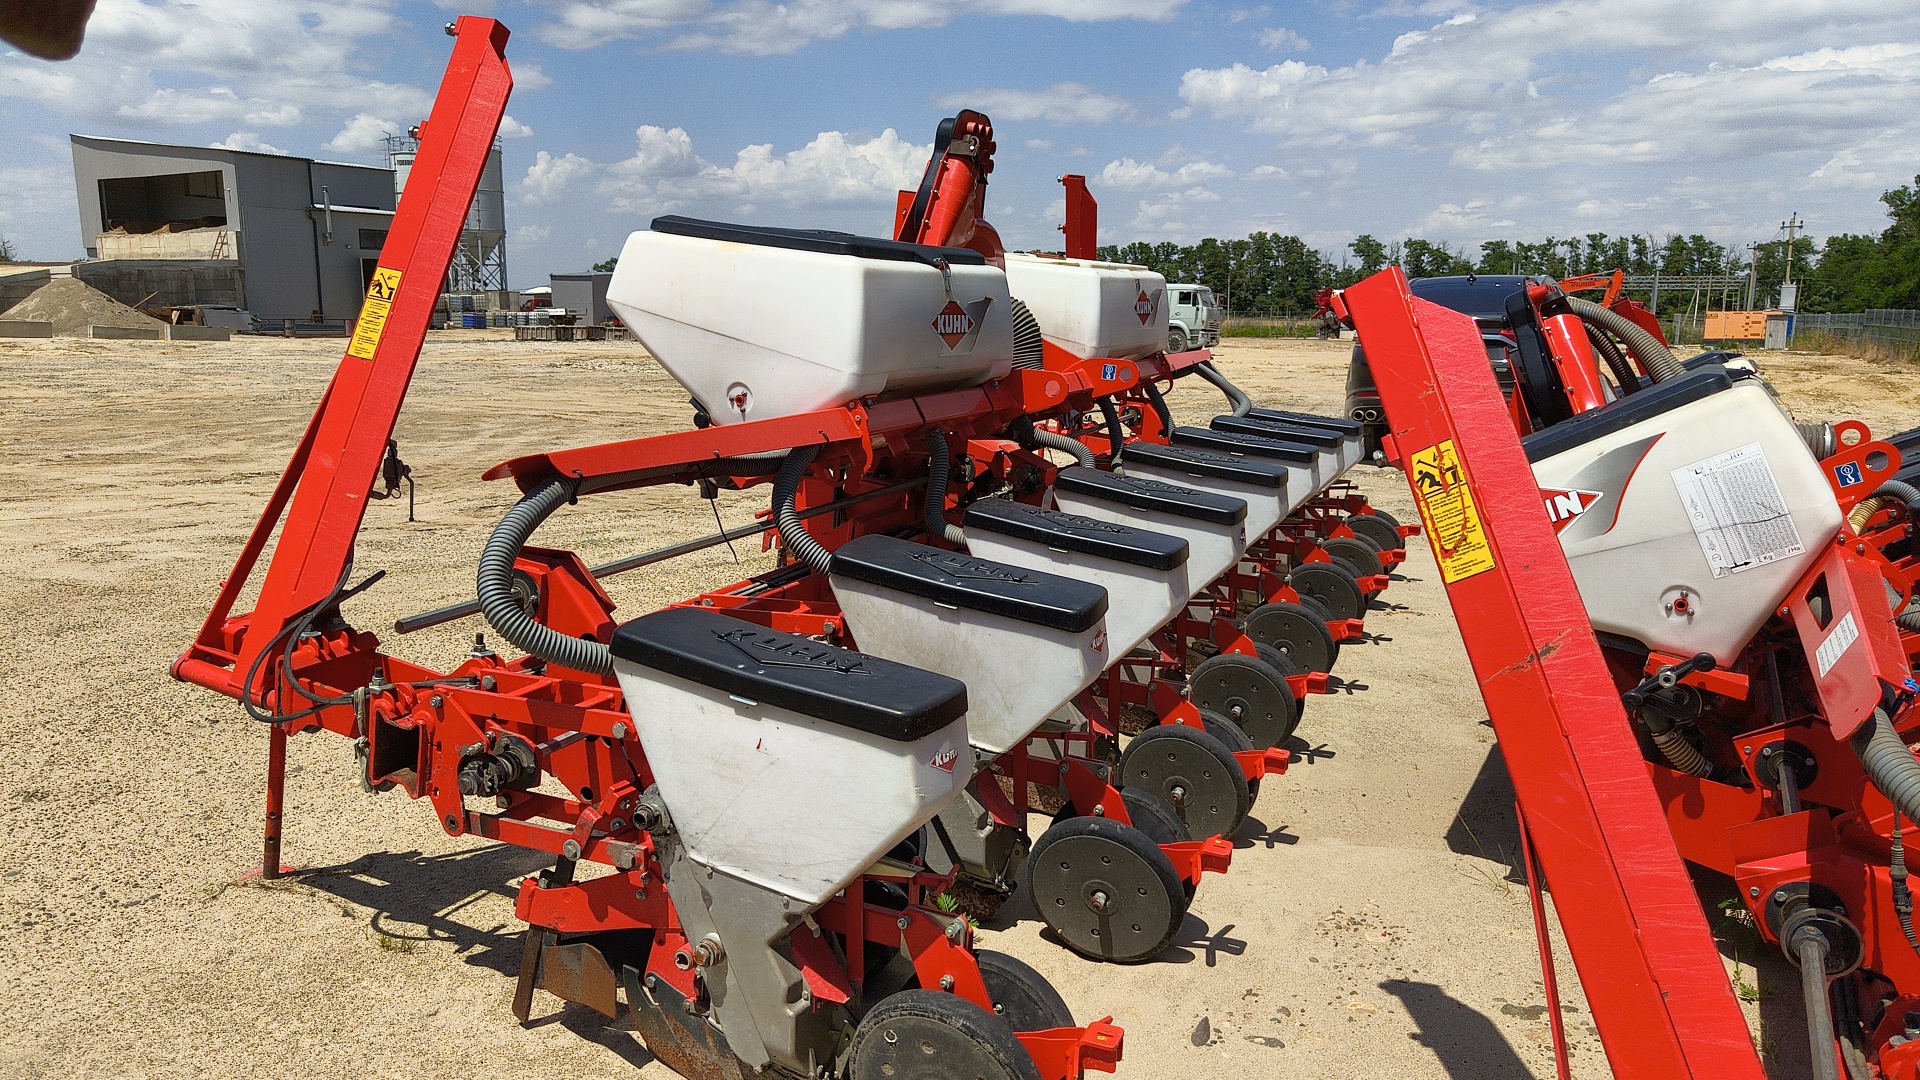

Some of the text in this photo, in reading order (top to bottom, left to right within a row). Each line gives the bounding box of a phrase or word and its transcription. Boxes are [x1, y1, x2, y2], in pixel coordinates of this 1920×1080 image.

[1136, 301, 1152, 315] KUHN
[937, 314, 969, 334] KUHN
[913, 551, 1029, 583] KUHN
[718, 629, 862, 673] KUHN
